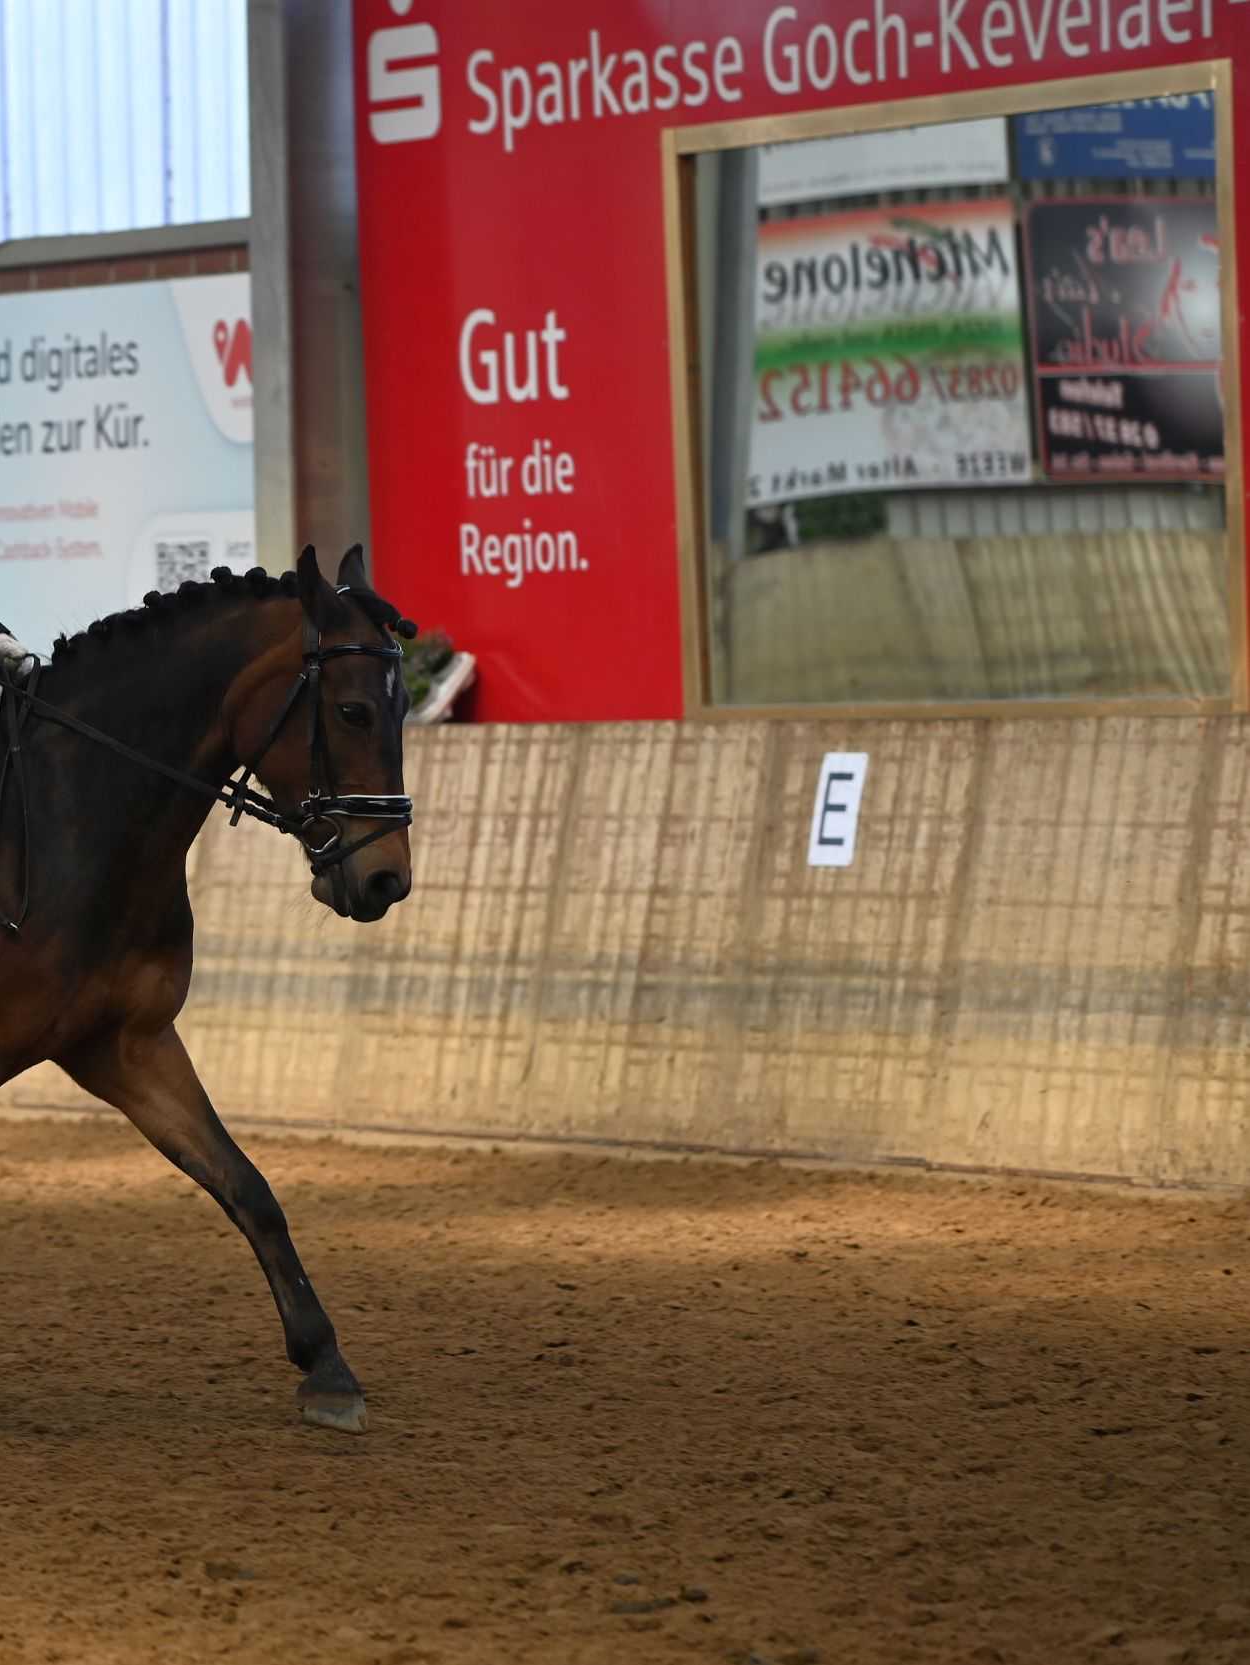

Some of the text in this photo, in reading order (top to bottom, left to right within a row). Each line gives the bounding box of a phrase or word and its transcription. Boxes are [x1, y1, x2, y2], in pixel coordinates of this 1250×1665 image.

[467, 0, 1250, 153] Sparkasse Goch-Kevelaer
[21, 331, 139, 392] digitales
[459, 308, 569, 404] Gut
[41, 418, 85, 453] zur
[94, 402, 149, 450] Kür.
[465, 438, 575, 498] für die
[459, 517, 589, 588] Region.
[818, 773, 854, 845] E
